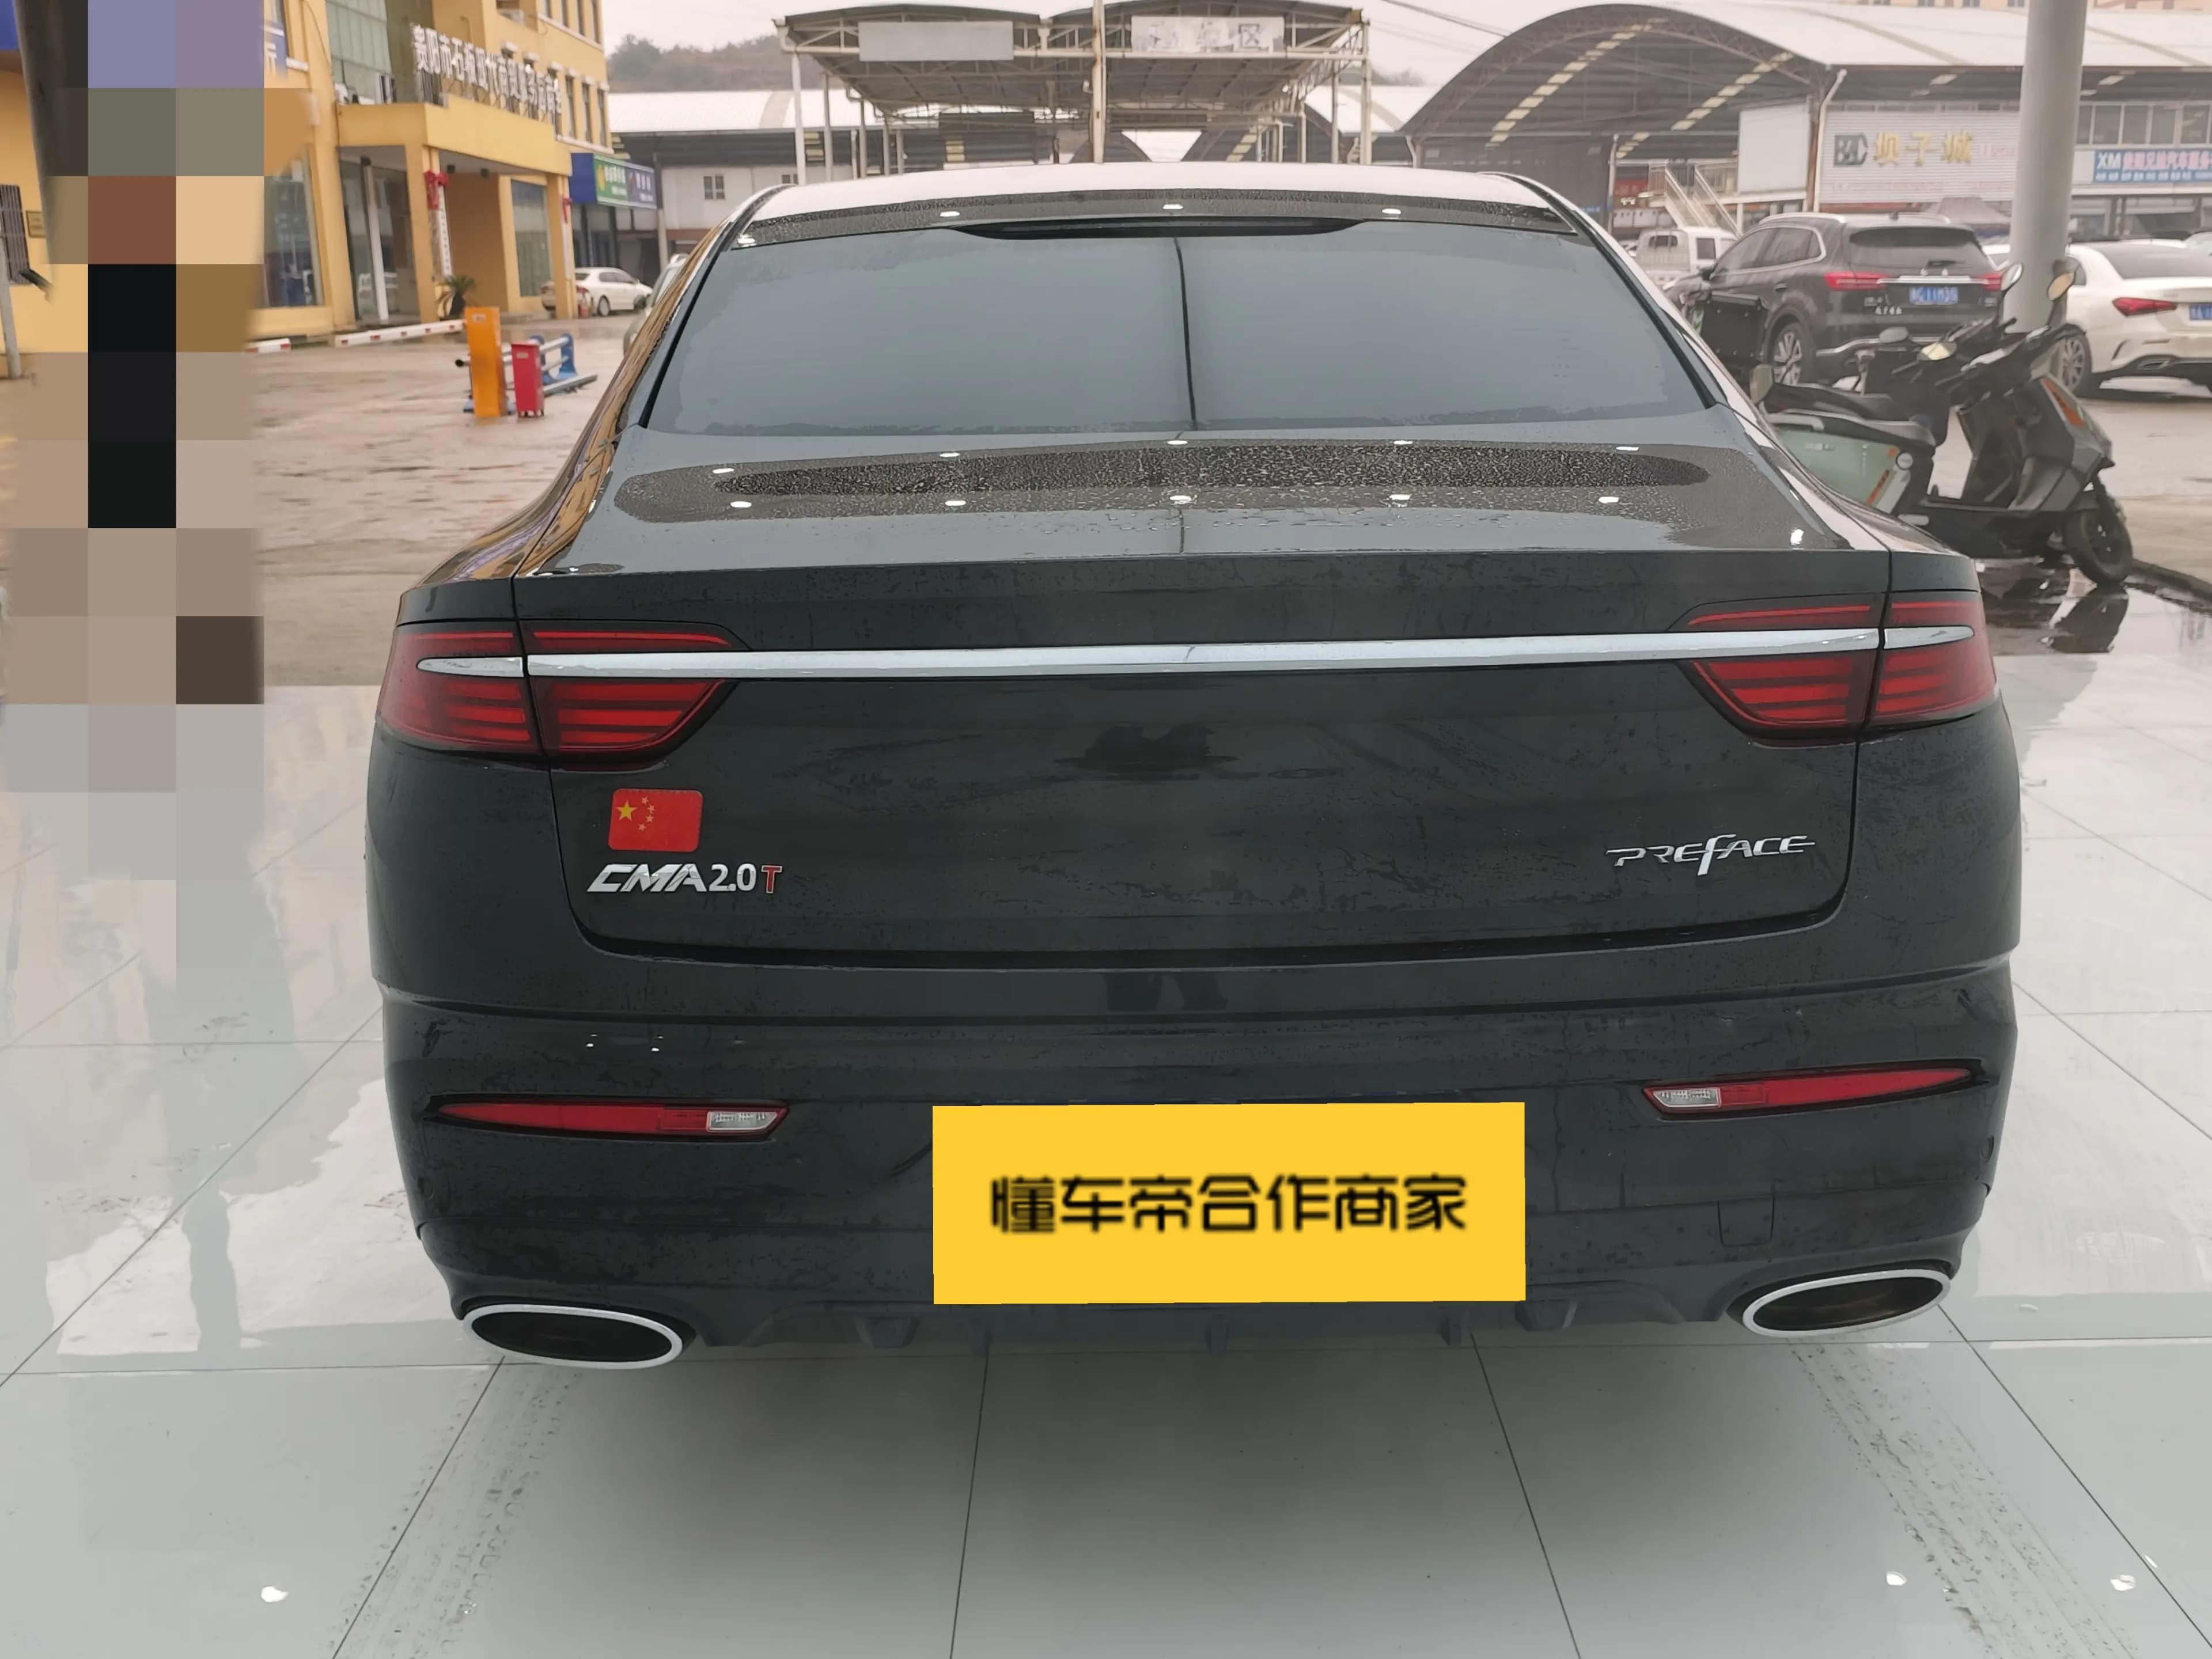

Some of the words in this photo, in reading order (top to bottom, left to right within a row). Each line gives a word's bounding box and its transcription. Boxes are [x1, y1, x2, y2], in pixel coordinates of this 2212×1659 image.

[1873, 130, 1973, 167] 坝子城
[2096, 151, 2122, 169] XM
[1605, 834, 1815, 876] PREFACE
[586, 863, 707, 892] CMA
[709, 863, 783, 893] 2.0T
